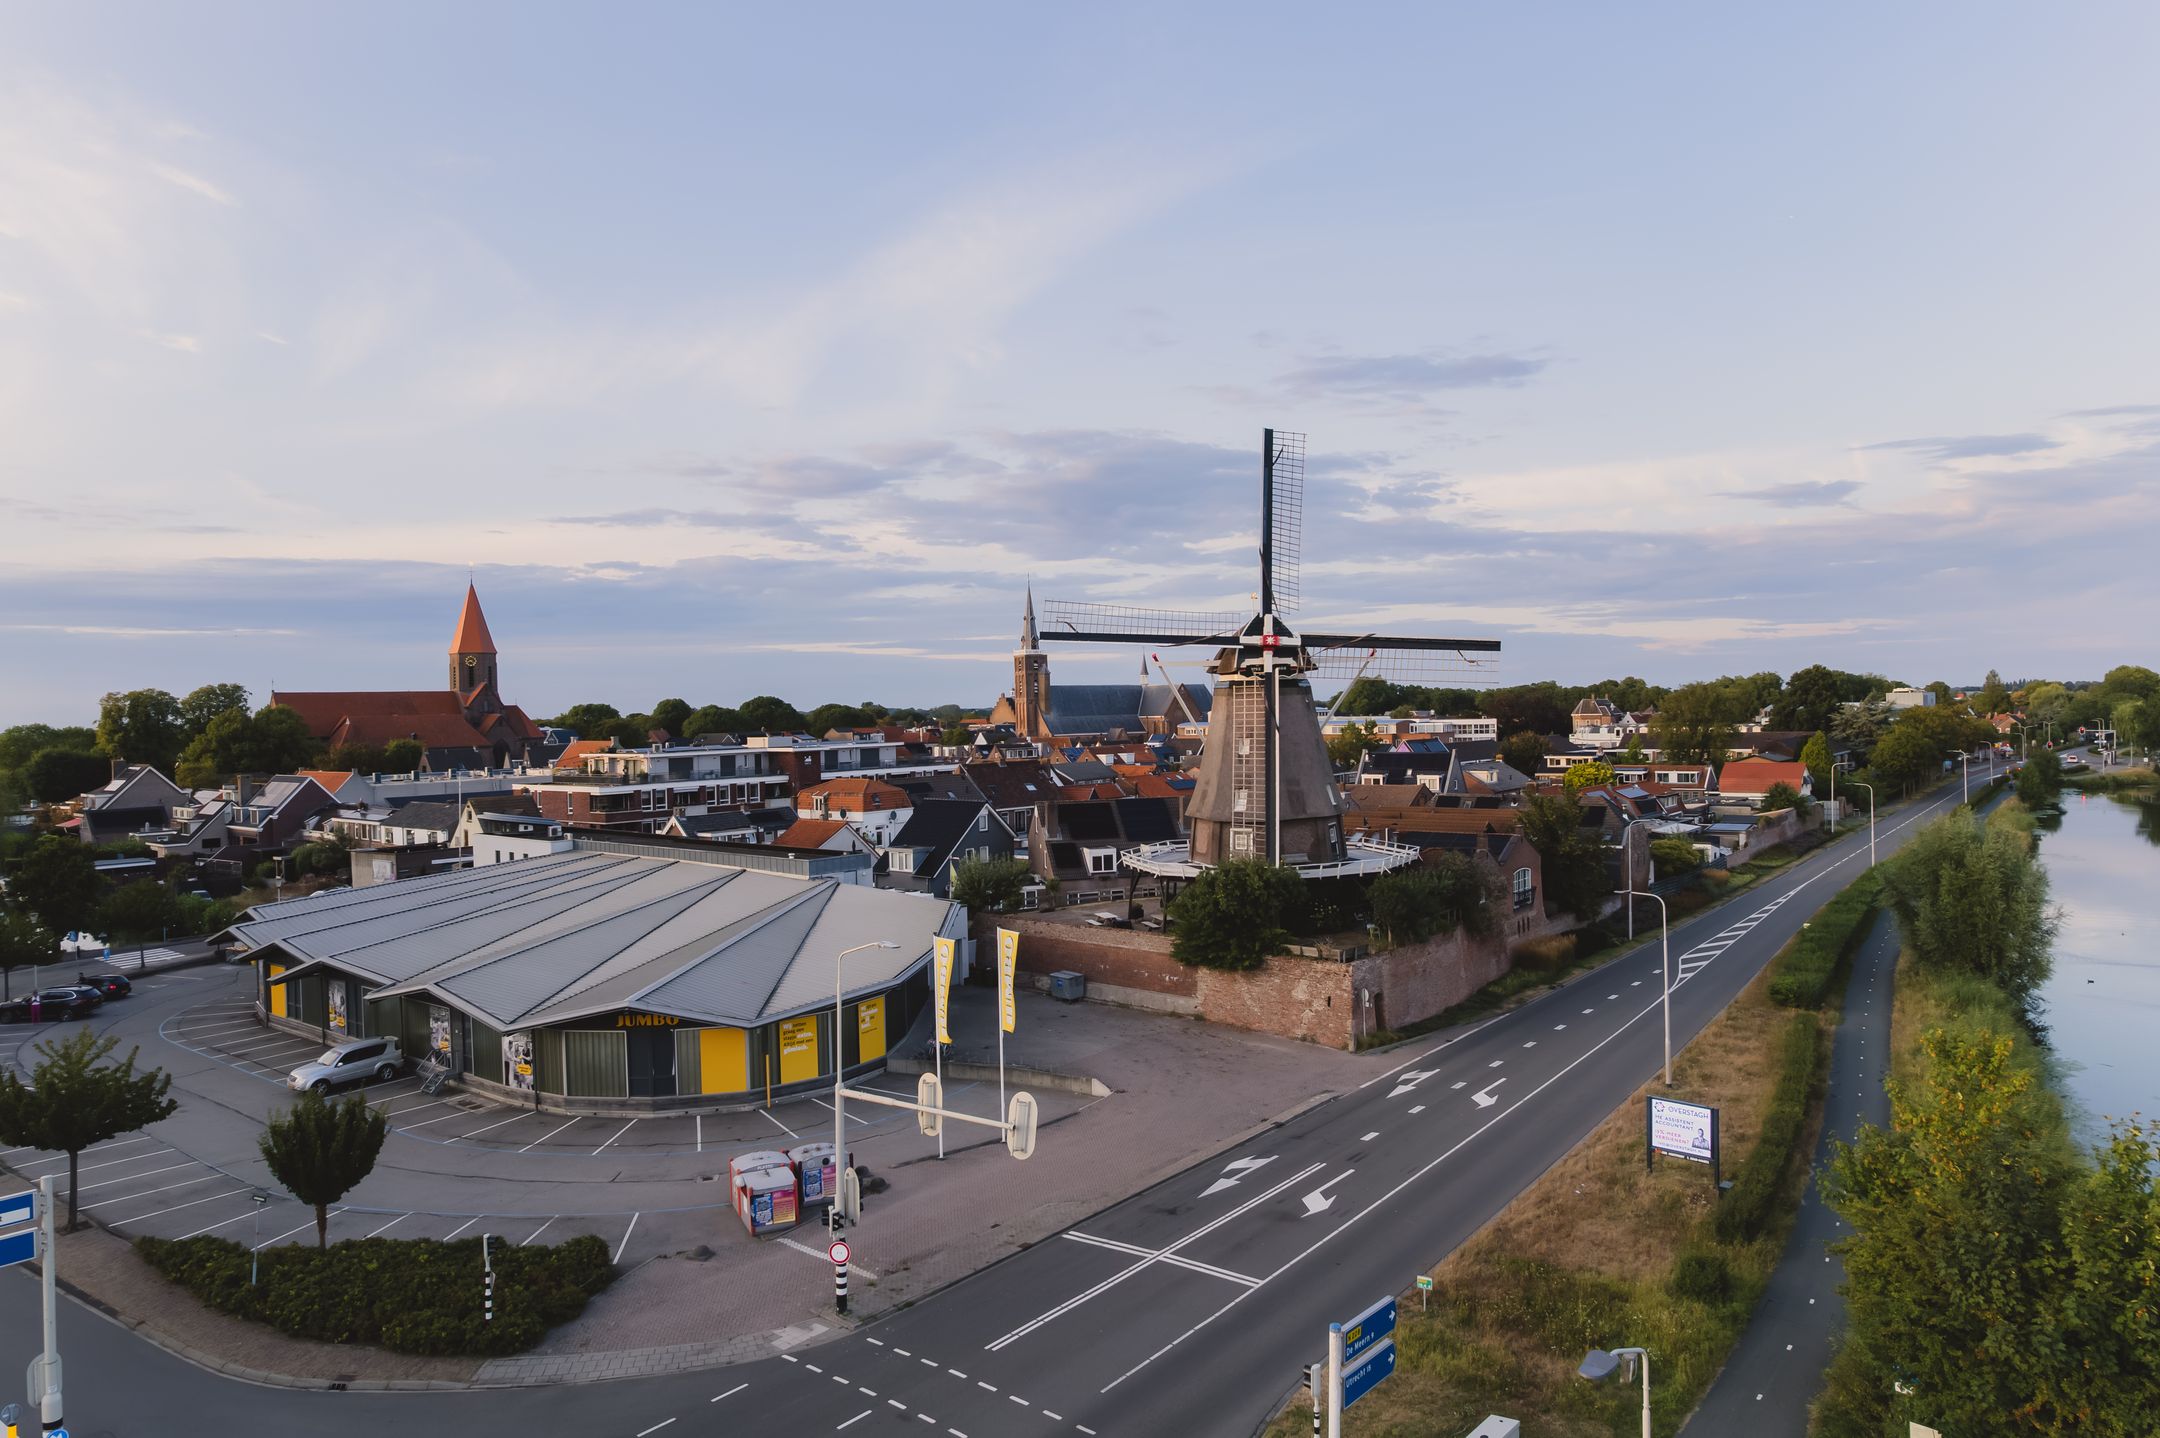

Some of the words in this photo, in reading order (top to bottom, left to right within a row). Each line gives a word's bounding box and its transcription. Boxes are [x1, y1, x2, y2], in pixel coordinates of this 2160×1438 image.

[615, 1013, 679, 1027] JUMBO
[1668, 1106, 1709, 1118] OVERSTAGH
[1346, 1346, 1353, 1357] De
[1354, 1335, 1371, 1351] Meern
[1345, 1367, 1366, 1388] Utrecht
